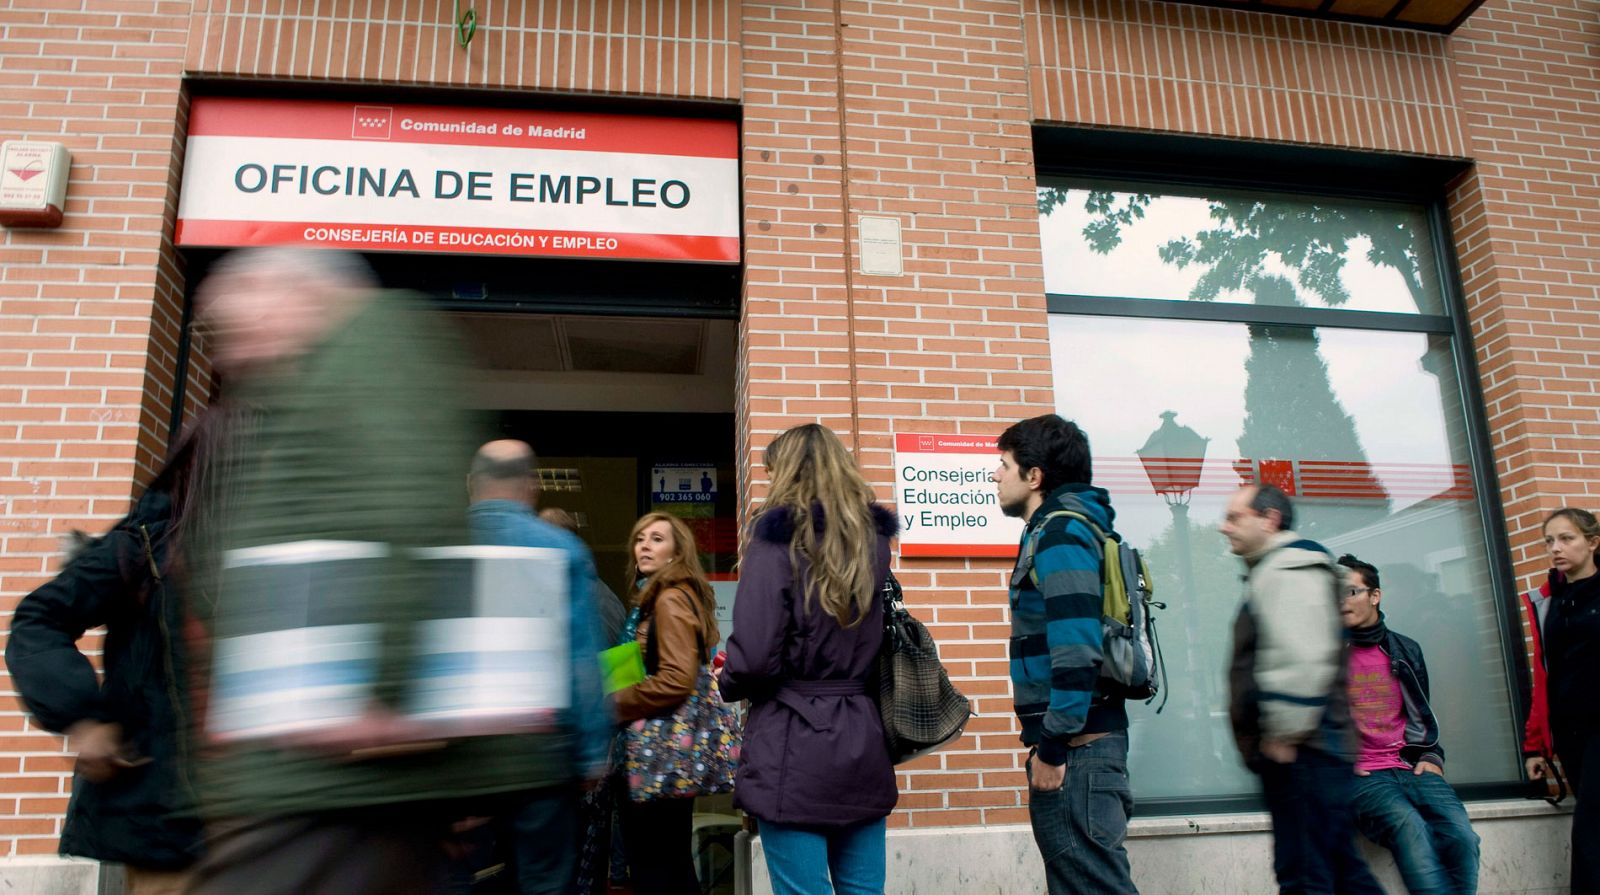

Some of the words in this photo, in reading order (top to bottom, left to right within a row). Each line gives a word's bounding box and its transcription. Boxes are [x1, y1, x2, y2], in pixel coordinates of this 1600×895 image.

[400, 118, 497, 135] Comunidad
[502, 124, 523, 136] de
[528, 125, 586, 140] Madrid
[234, 163, 421, 199] OFICINA
[434, 169, 493, 201] DE
[509, 172, 691, 209] EMPLEO
[303, 227, 408, 244] CONSEJERÍA
[412, 231, 434, 244] DE
[438, 232, 535, 248] EDUCACIÓN
[538, 235, 550, 248] Y
[552, 236, 618, 250] EMPLEO
[902, 466, 995, 486] Consejería
[660, 493, 676, 501] 902
[677, 493, 693, 501] 365
[695, 493, 711, 501] 060
[903, 488, 996, 505] Educación
[904, 514, 914, 531] y
[920, 511, 988, 531] Empleo
